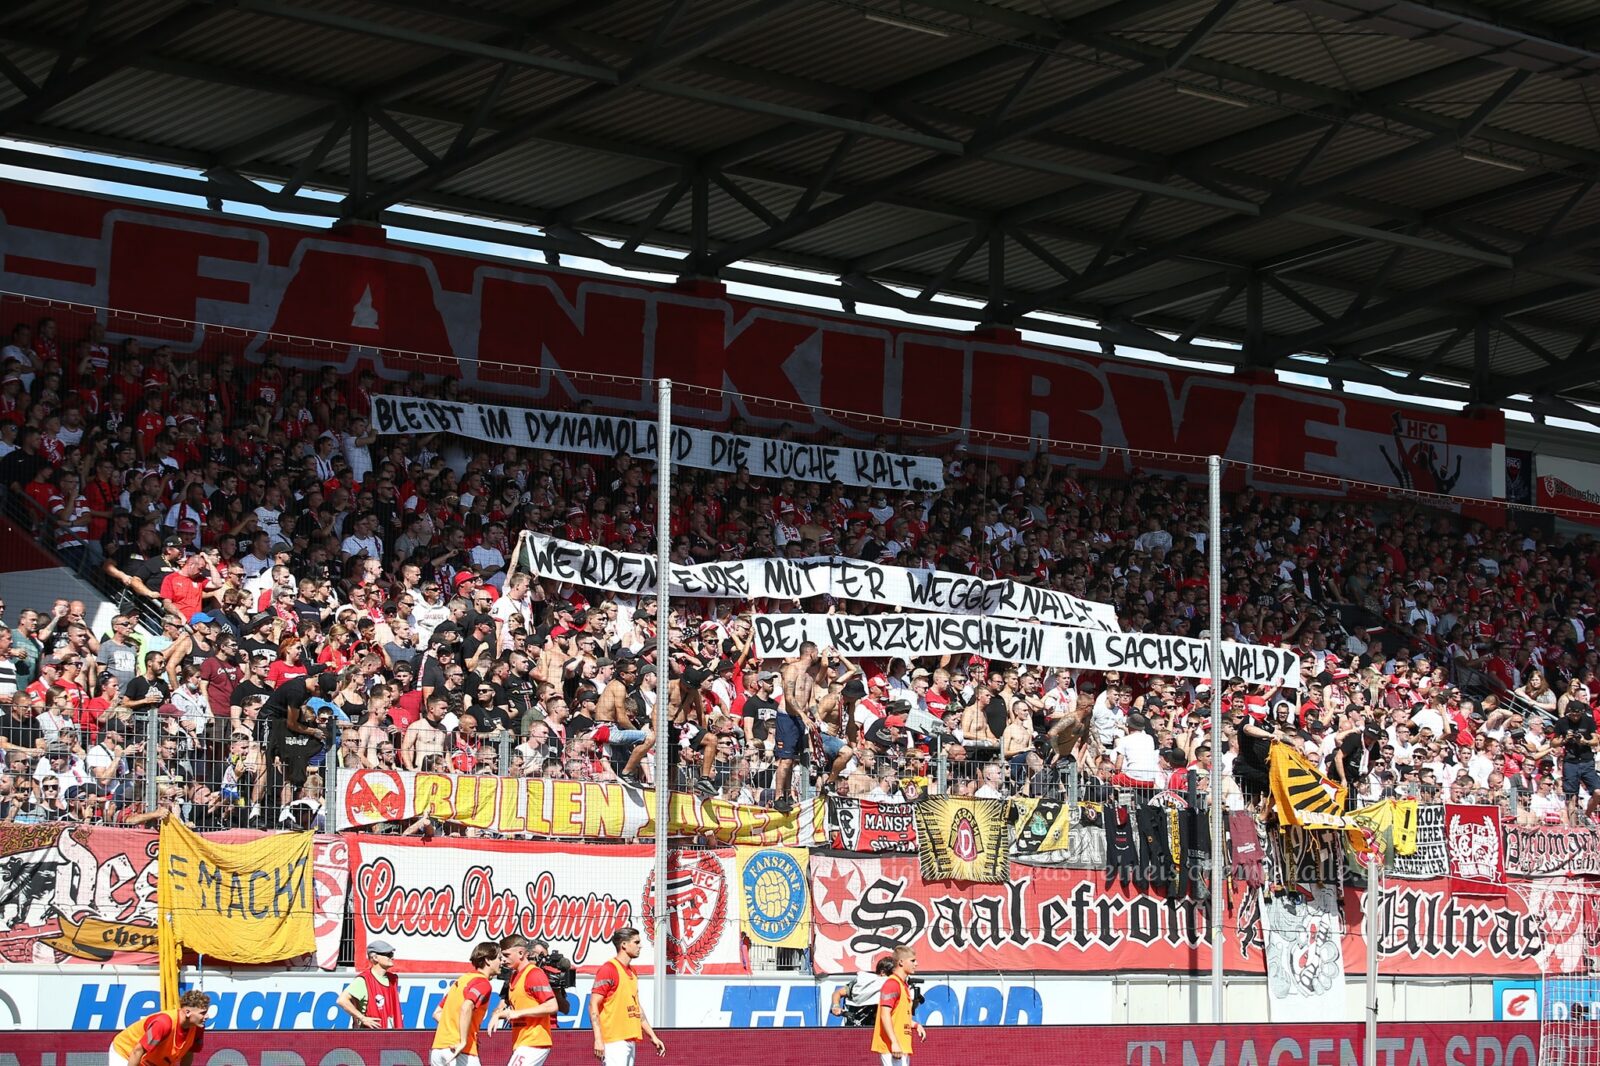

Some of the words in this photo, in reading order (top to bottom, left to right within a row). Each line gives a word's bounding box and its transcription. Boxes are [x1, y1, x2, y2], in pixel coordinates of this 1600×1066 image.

[100, 208, 1350, 495] FANKURVE
[524, 411, 693, 460] DYNAMOLAD
[763, 441, 840, 480] KÜCHE
[1407, 420, 1438, 440] HFC
[529, 534, 657, 593] WERDEN
[672, 562, 750, 597] EURE
[749, 855, 801, 893] FANSZENE
[357, 857, 454, 936] Coesa
[456, 865, 519, 941] Per
[521, 871, 632, 964] Sempre
[850, 878, 1226, 954] Saalefron
[1364, 886, 1547, 957] Ultras
